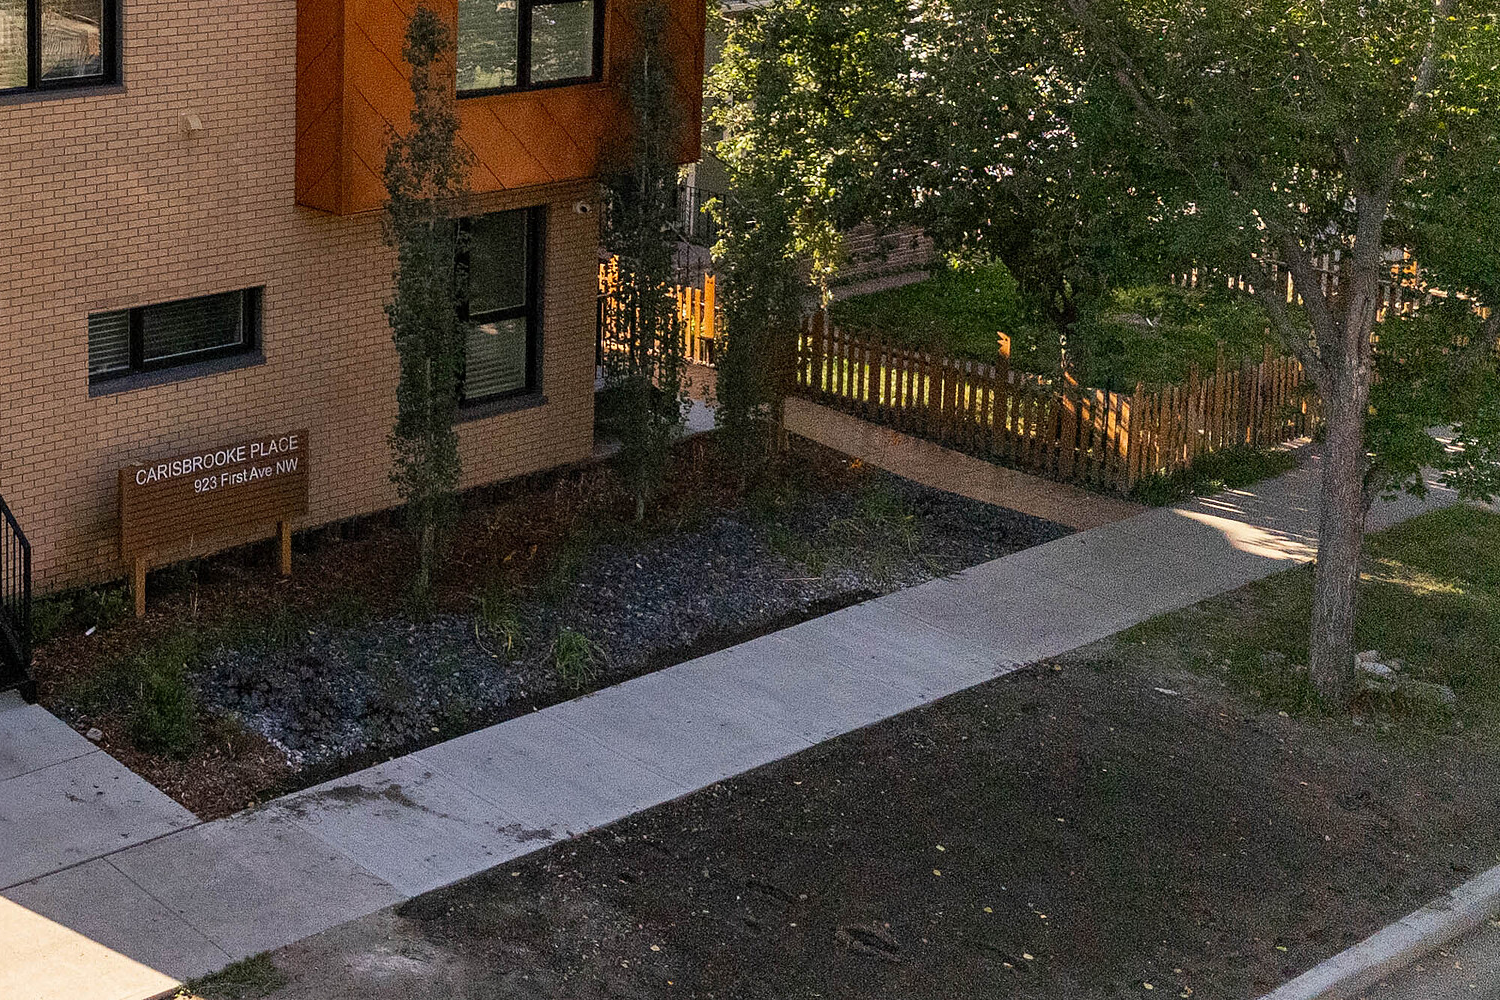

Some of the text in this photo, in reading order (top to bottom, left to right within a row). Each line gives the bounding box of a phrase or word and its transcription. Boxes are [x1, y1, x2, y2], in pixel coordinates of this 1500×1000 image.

[135, 435, 299, 485] CARISBROOKE PLACE
[194, 457, 299, 493] 923 First Ave NW
